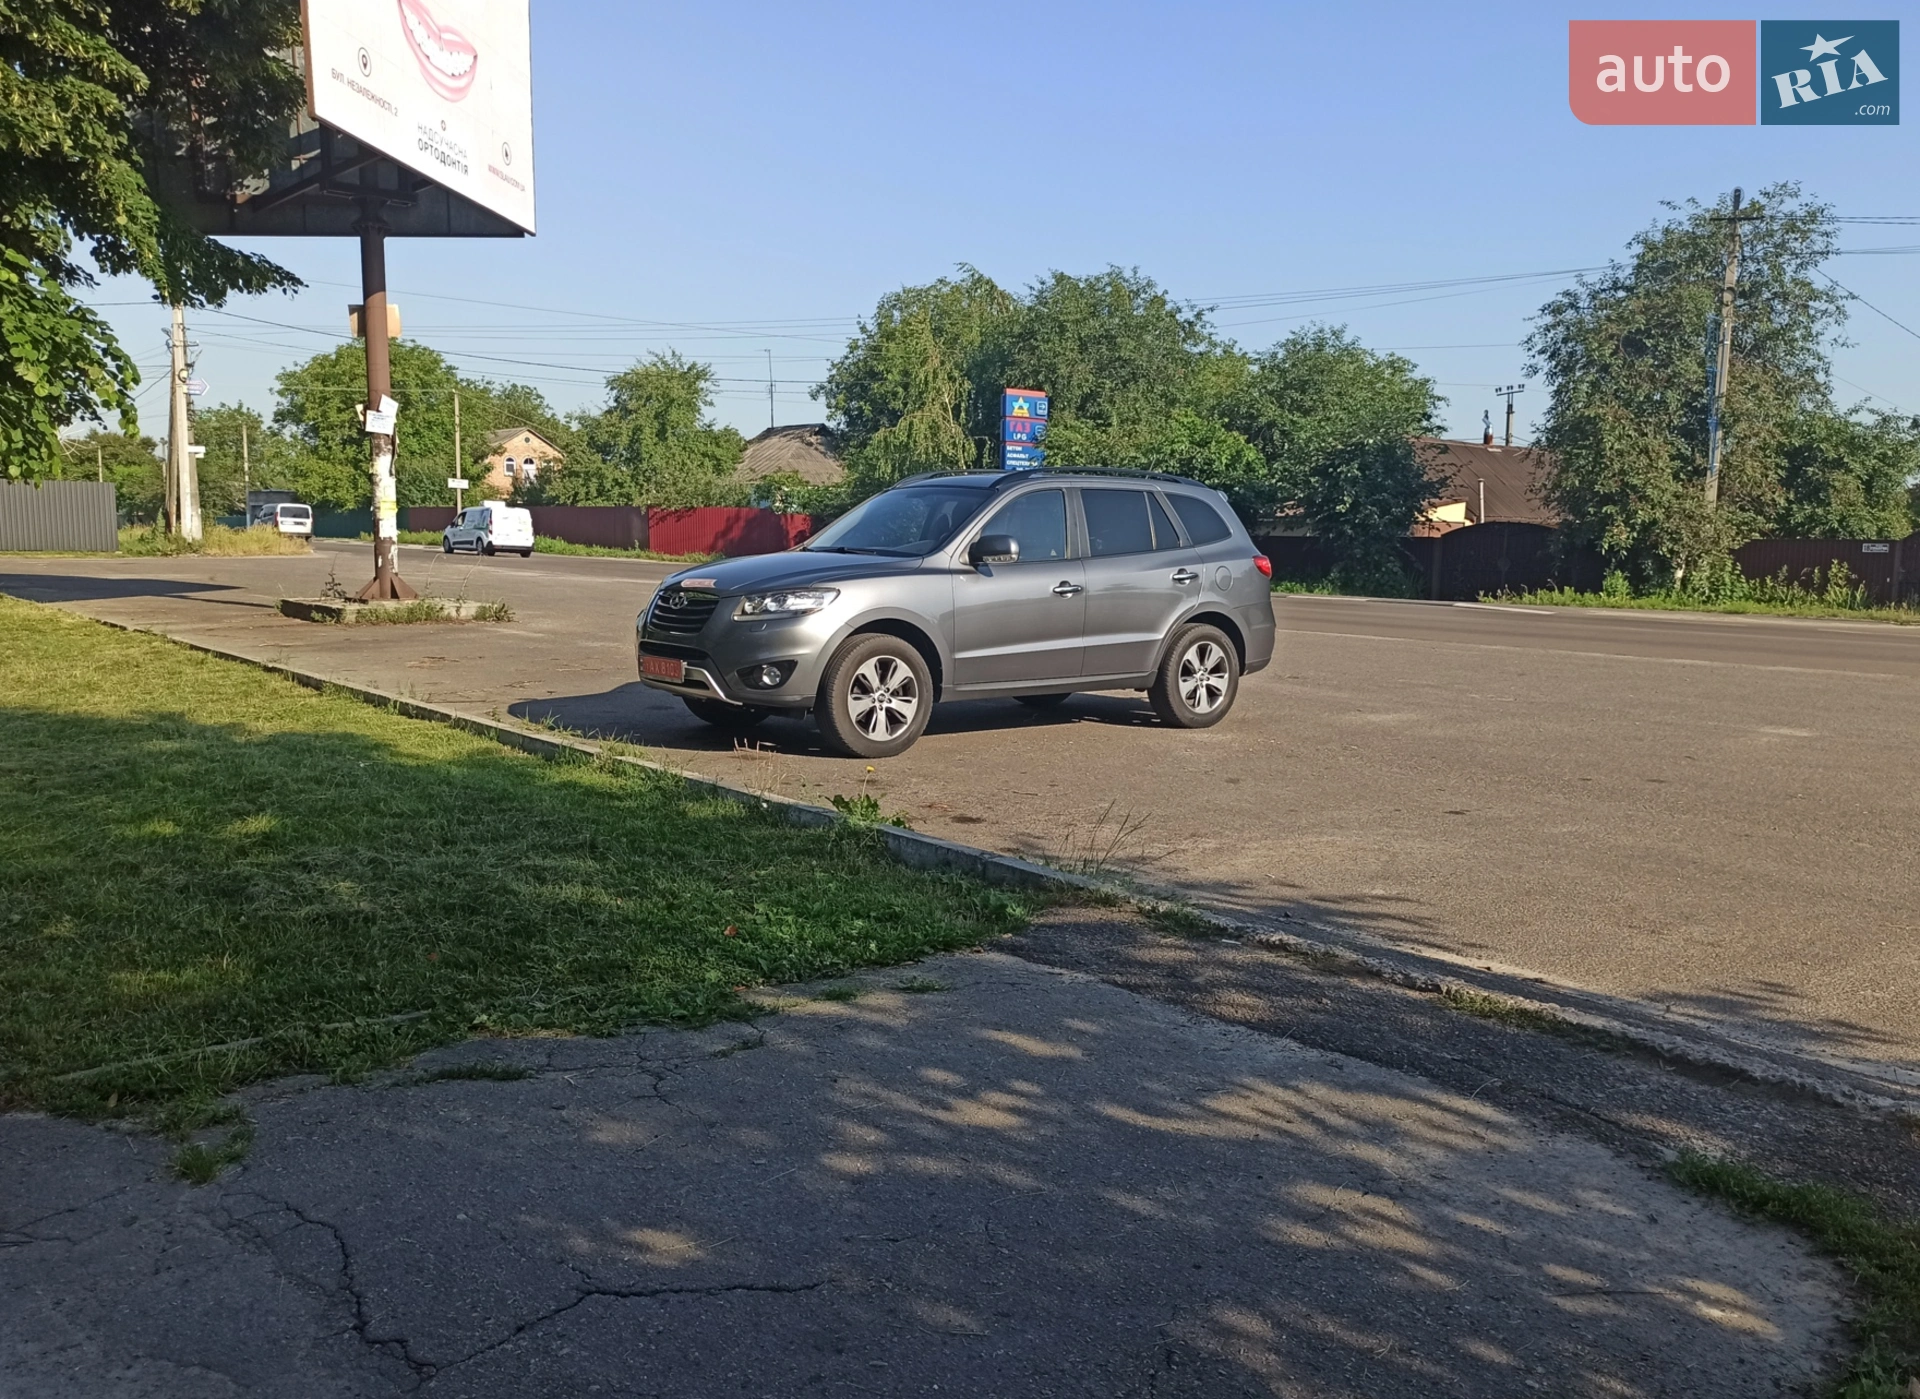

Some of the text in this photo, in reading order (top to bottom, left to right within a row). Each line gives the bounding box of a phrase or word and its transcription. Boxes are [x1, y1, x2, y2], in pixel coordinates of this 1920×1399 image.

[417, 122, 467, 159] НАДСУЧАСНА
[417, 138, 469, 176] ОРТОДОНТІЯ
[1009, 421, 1031, 433] ГАЗ
[1013, 432, 1027, 441] LPG
